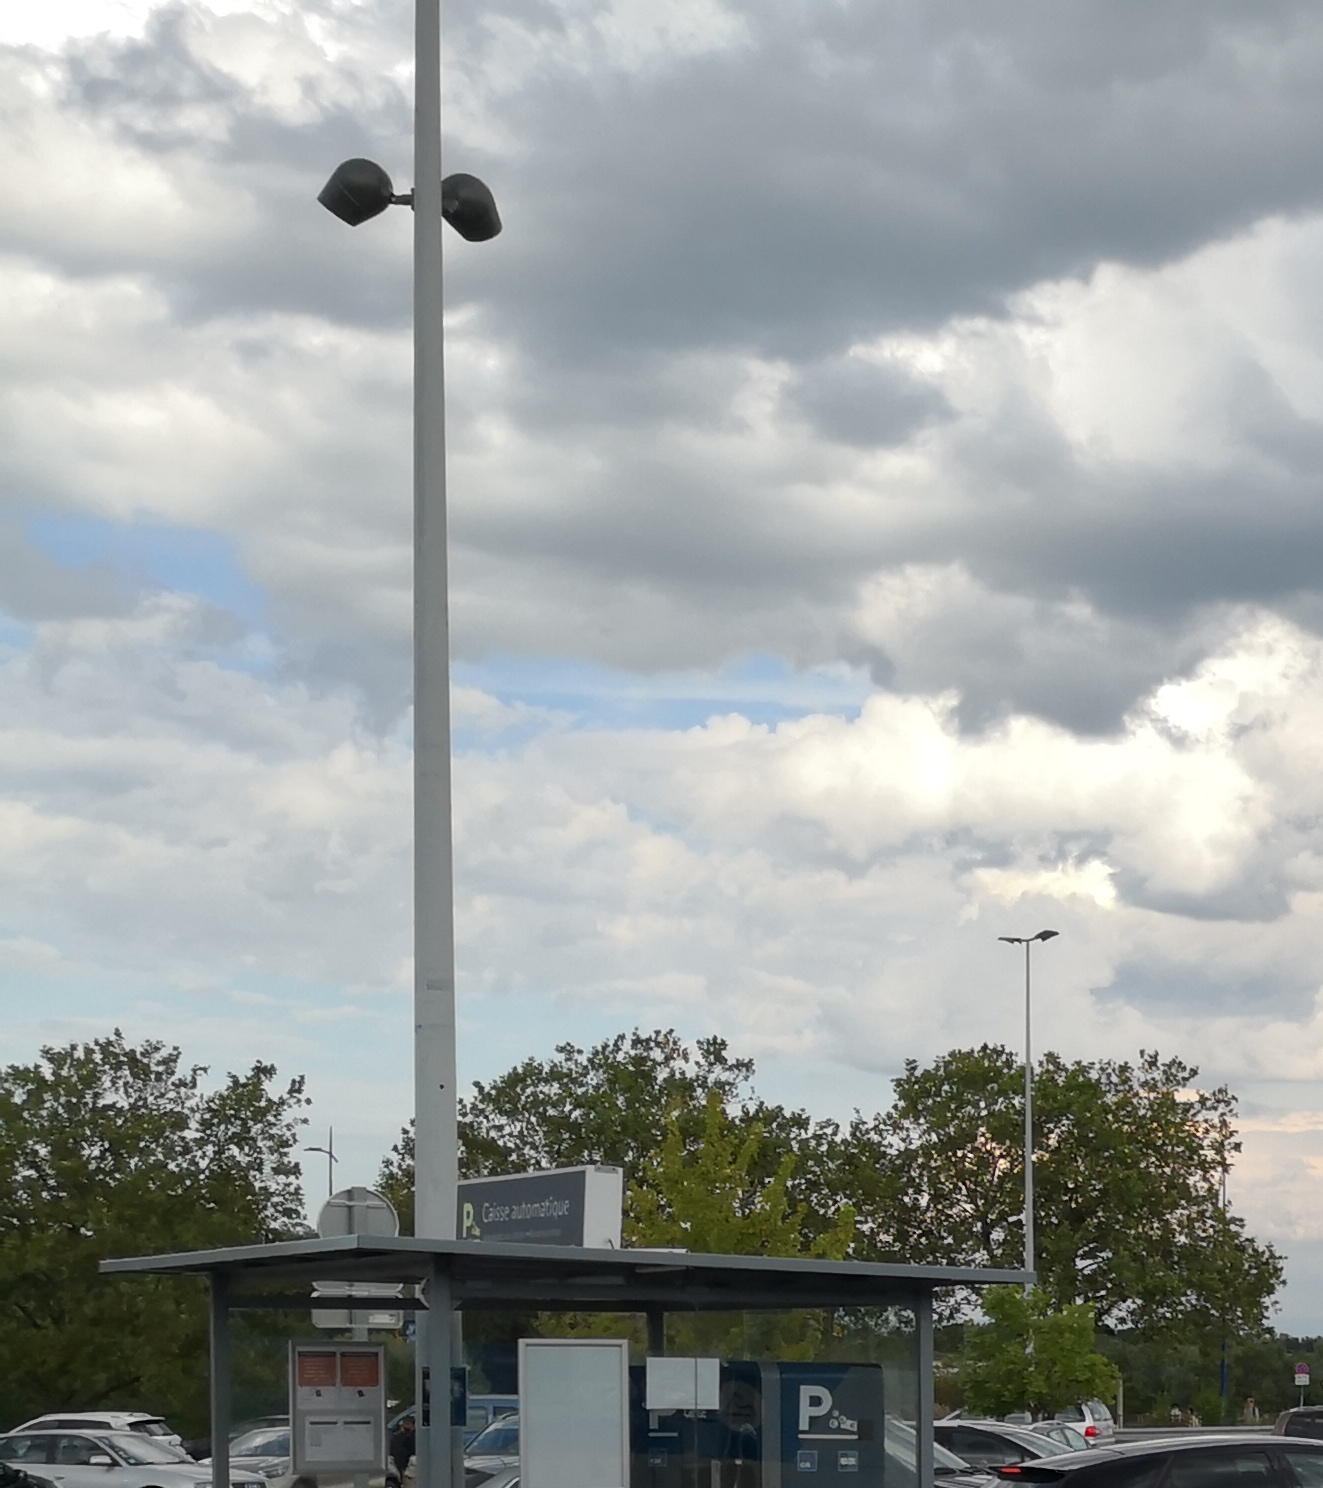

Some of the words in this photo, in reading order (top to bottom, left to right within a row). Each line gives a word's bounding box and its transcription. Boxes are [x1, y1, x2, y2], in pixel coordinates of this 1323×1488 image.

[482, 1201, 510, 1223] Caisse
[511, 1196, 570, 1220] automatique
[799, 1385, 833, 1431] P
